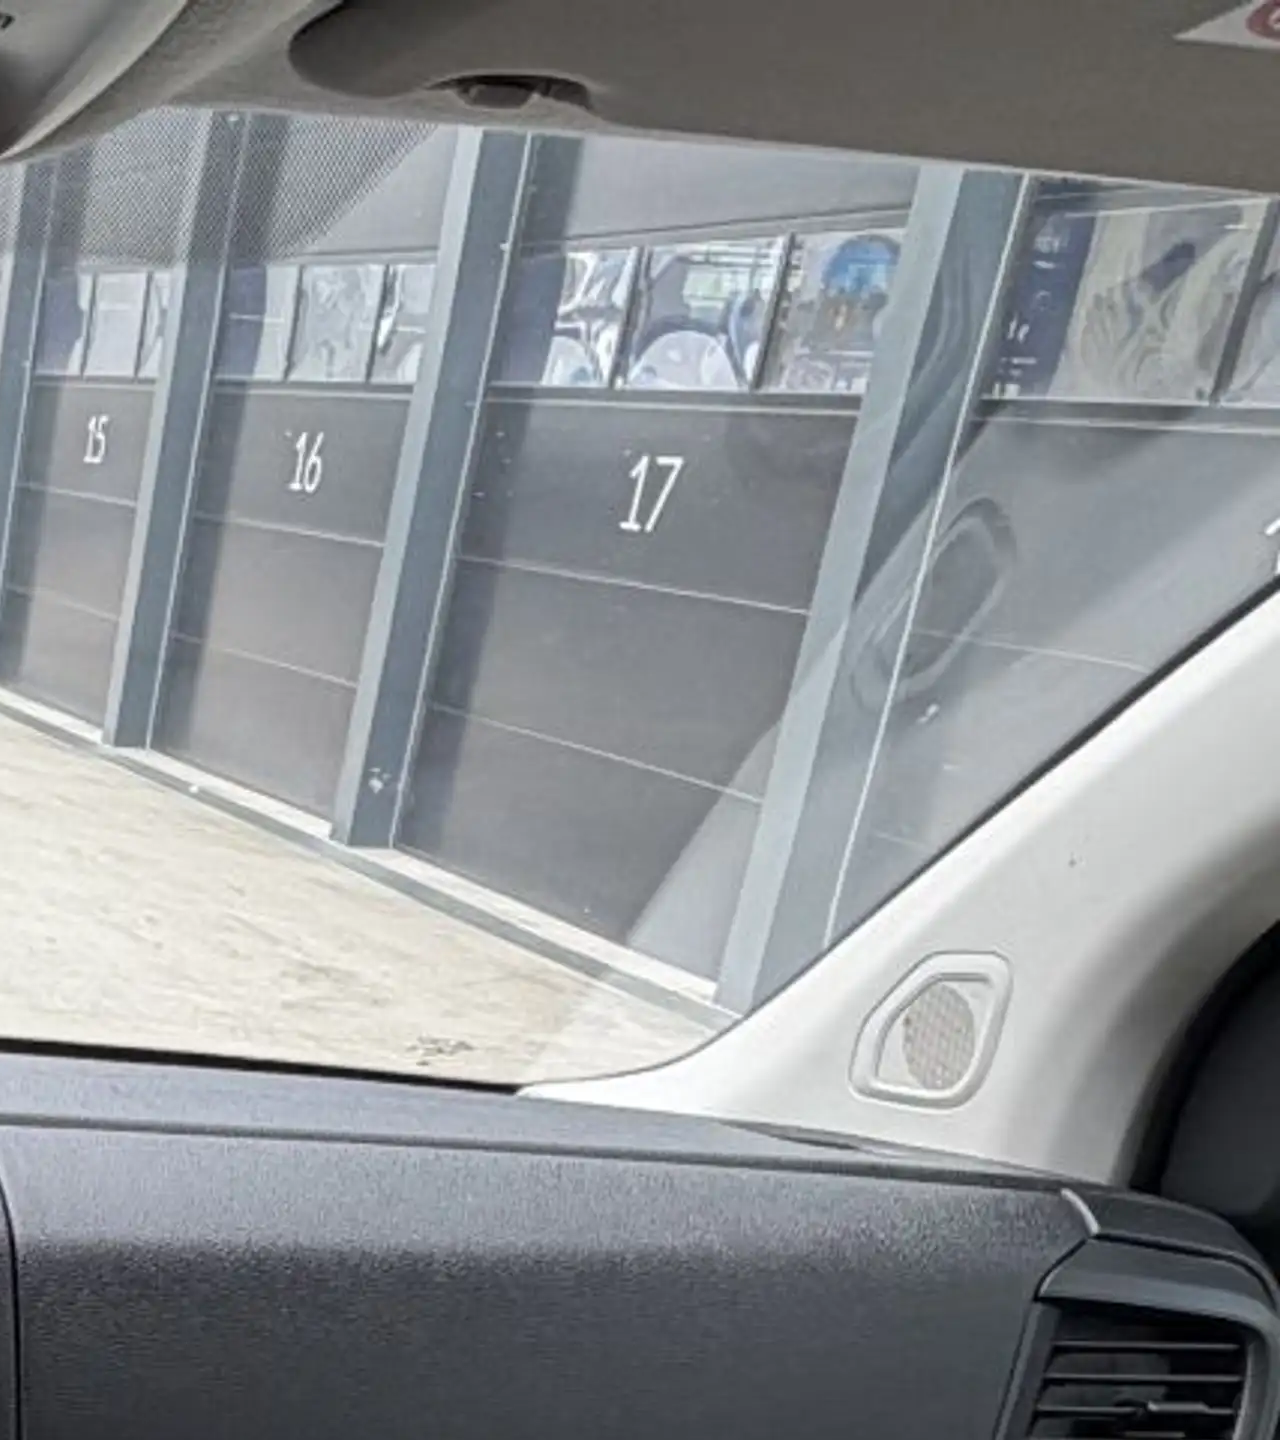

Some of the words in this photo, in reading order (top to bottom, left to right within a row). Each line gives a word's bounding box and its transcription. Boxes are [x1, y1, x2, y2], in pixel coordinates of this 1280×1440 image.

[83, 413, 111, 464] 15
[287, 431, 325, 493] 16
[618, 453, 684, 533] 17
